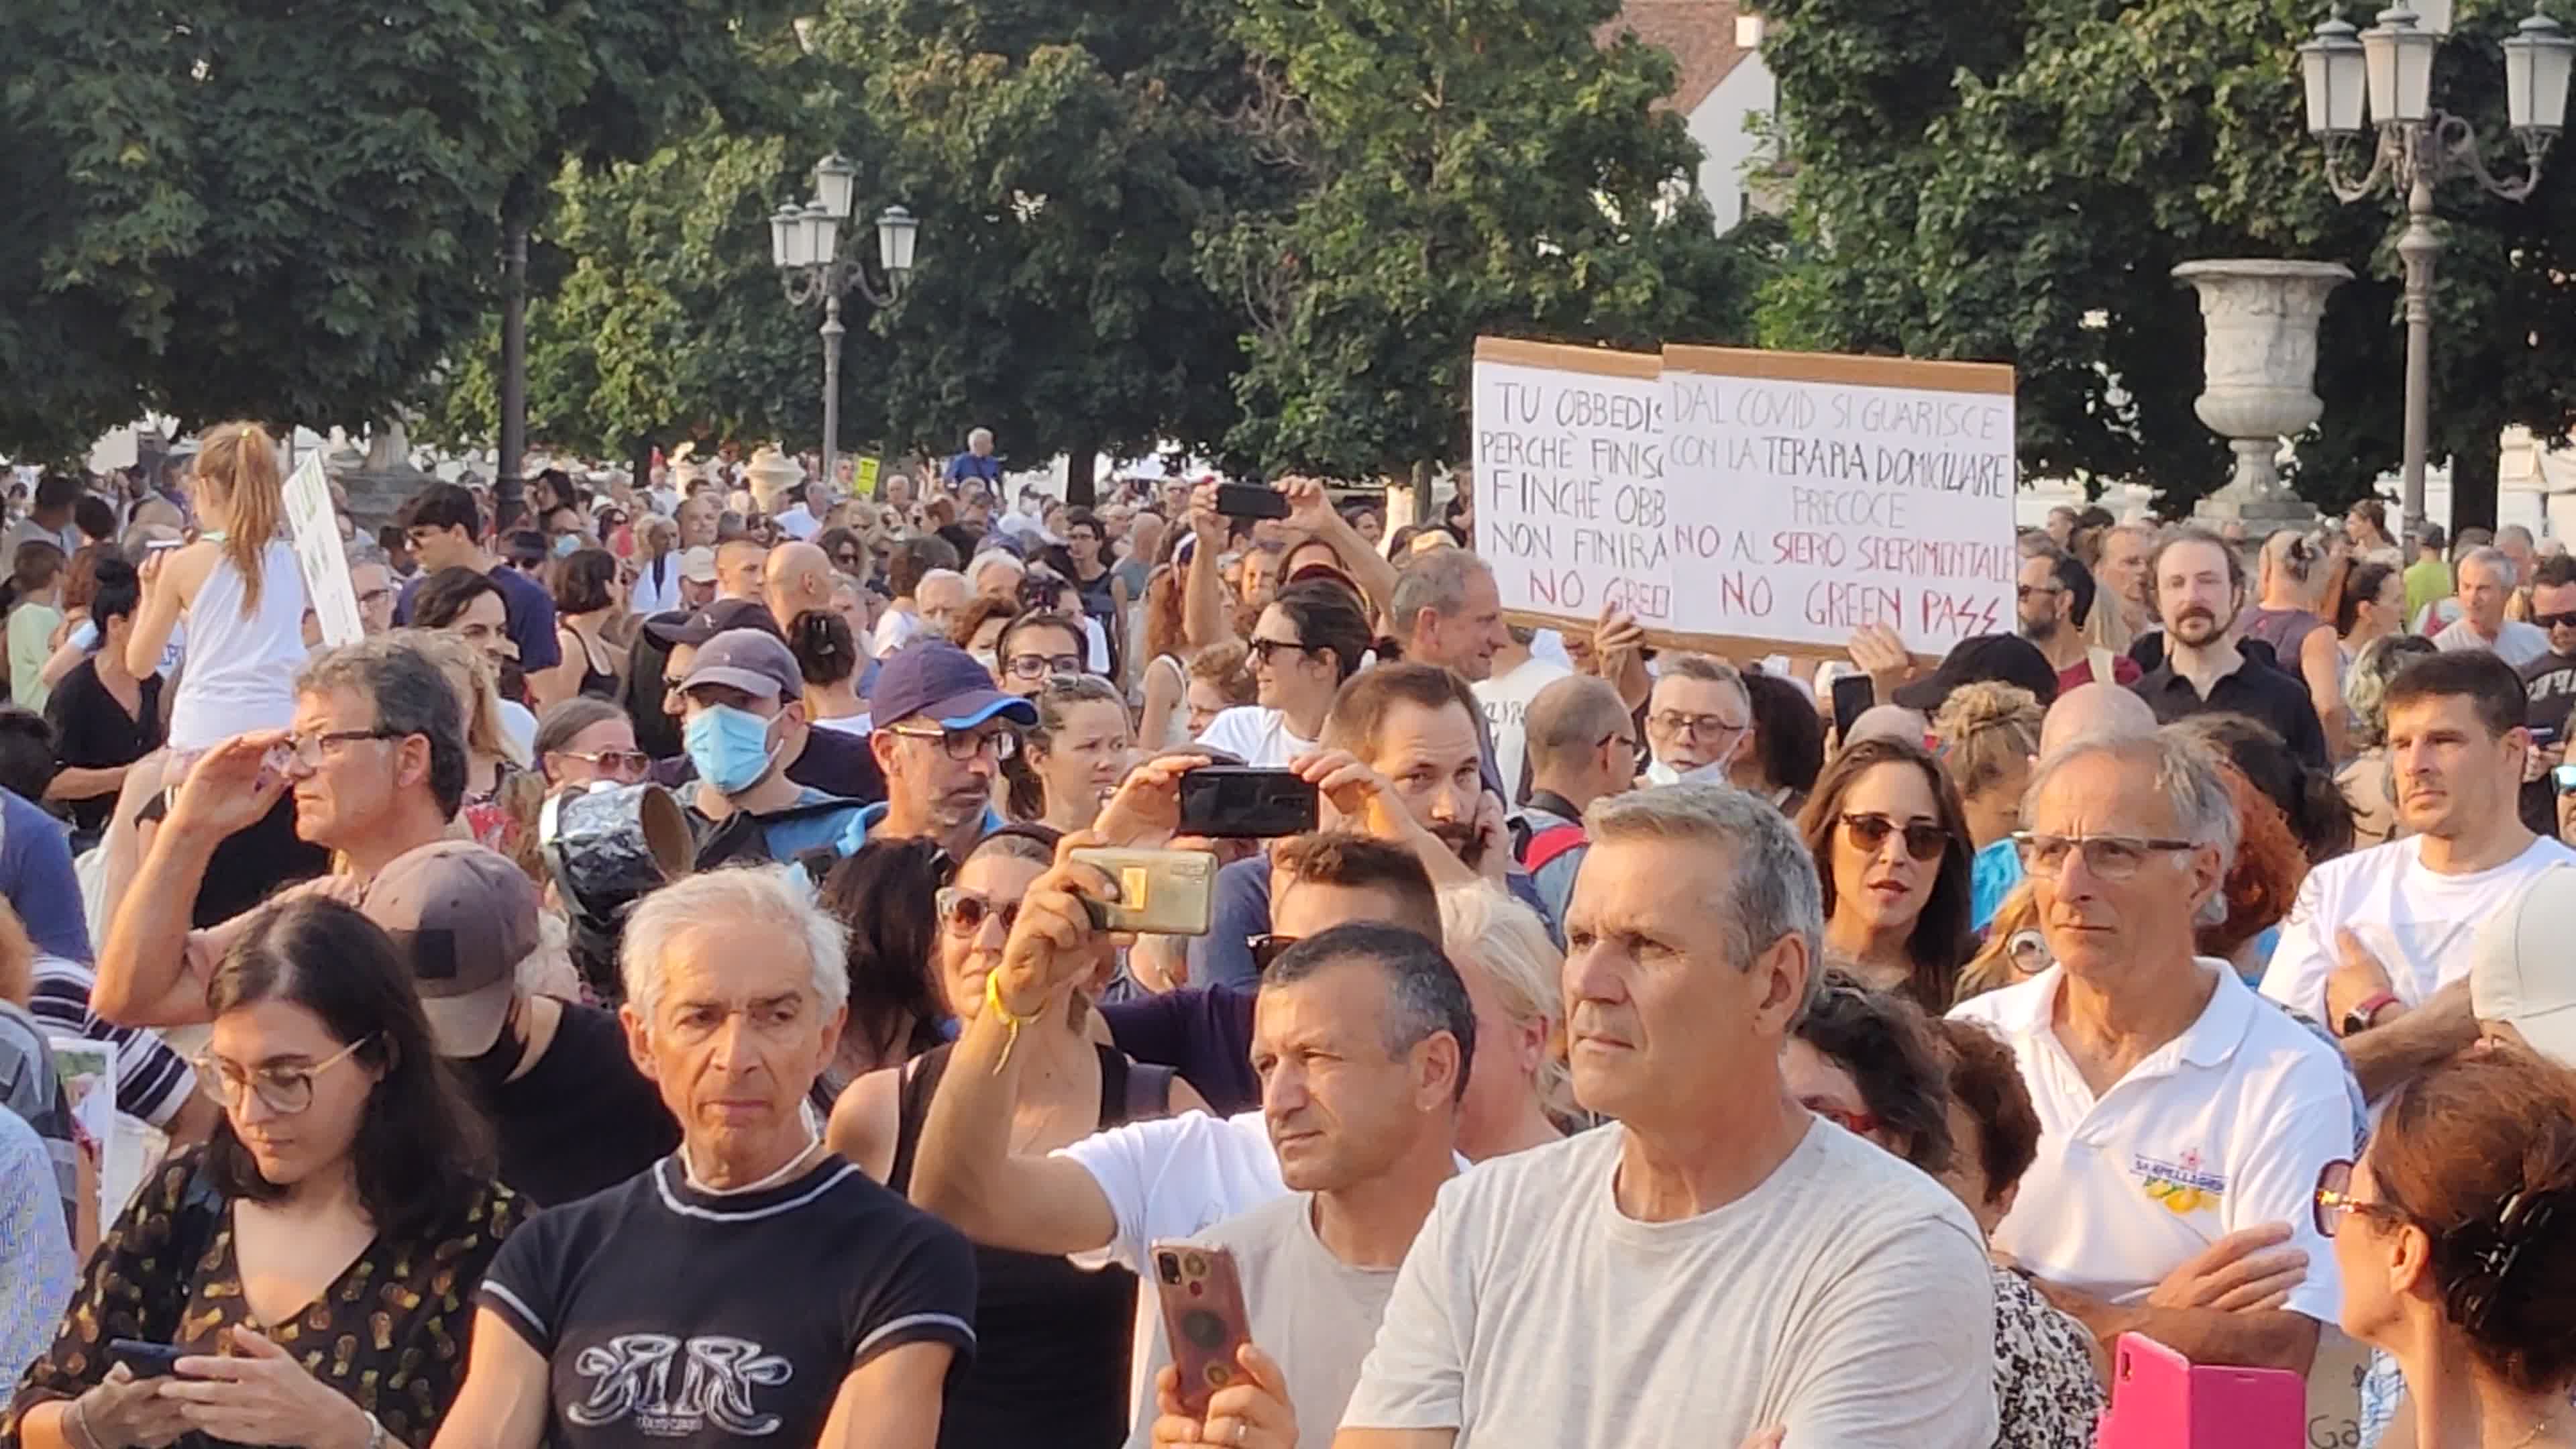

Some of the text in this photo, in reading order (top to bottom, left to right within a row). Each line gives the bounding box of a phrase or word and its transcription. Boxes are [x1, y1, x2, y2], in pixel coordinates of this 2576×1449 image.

[1494, 382, 1541, 423] TU
[1673, 381, 2002, 440] DAL COVID SI GUARISCE
[1670, 435, 2008, 498] CON LA TERAPIA DOMICILIARE
[1792, 486, 1908, 529] PRECOCE
[1492, 521, 1552, 559] NON
[1675, 525, 2013, 584] NO AL SIERO SPERIMENTALE
[1530, 569, 1585, 608] NO
[1721, 570, 2000, 637] NO GREEN PASS
